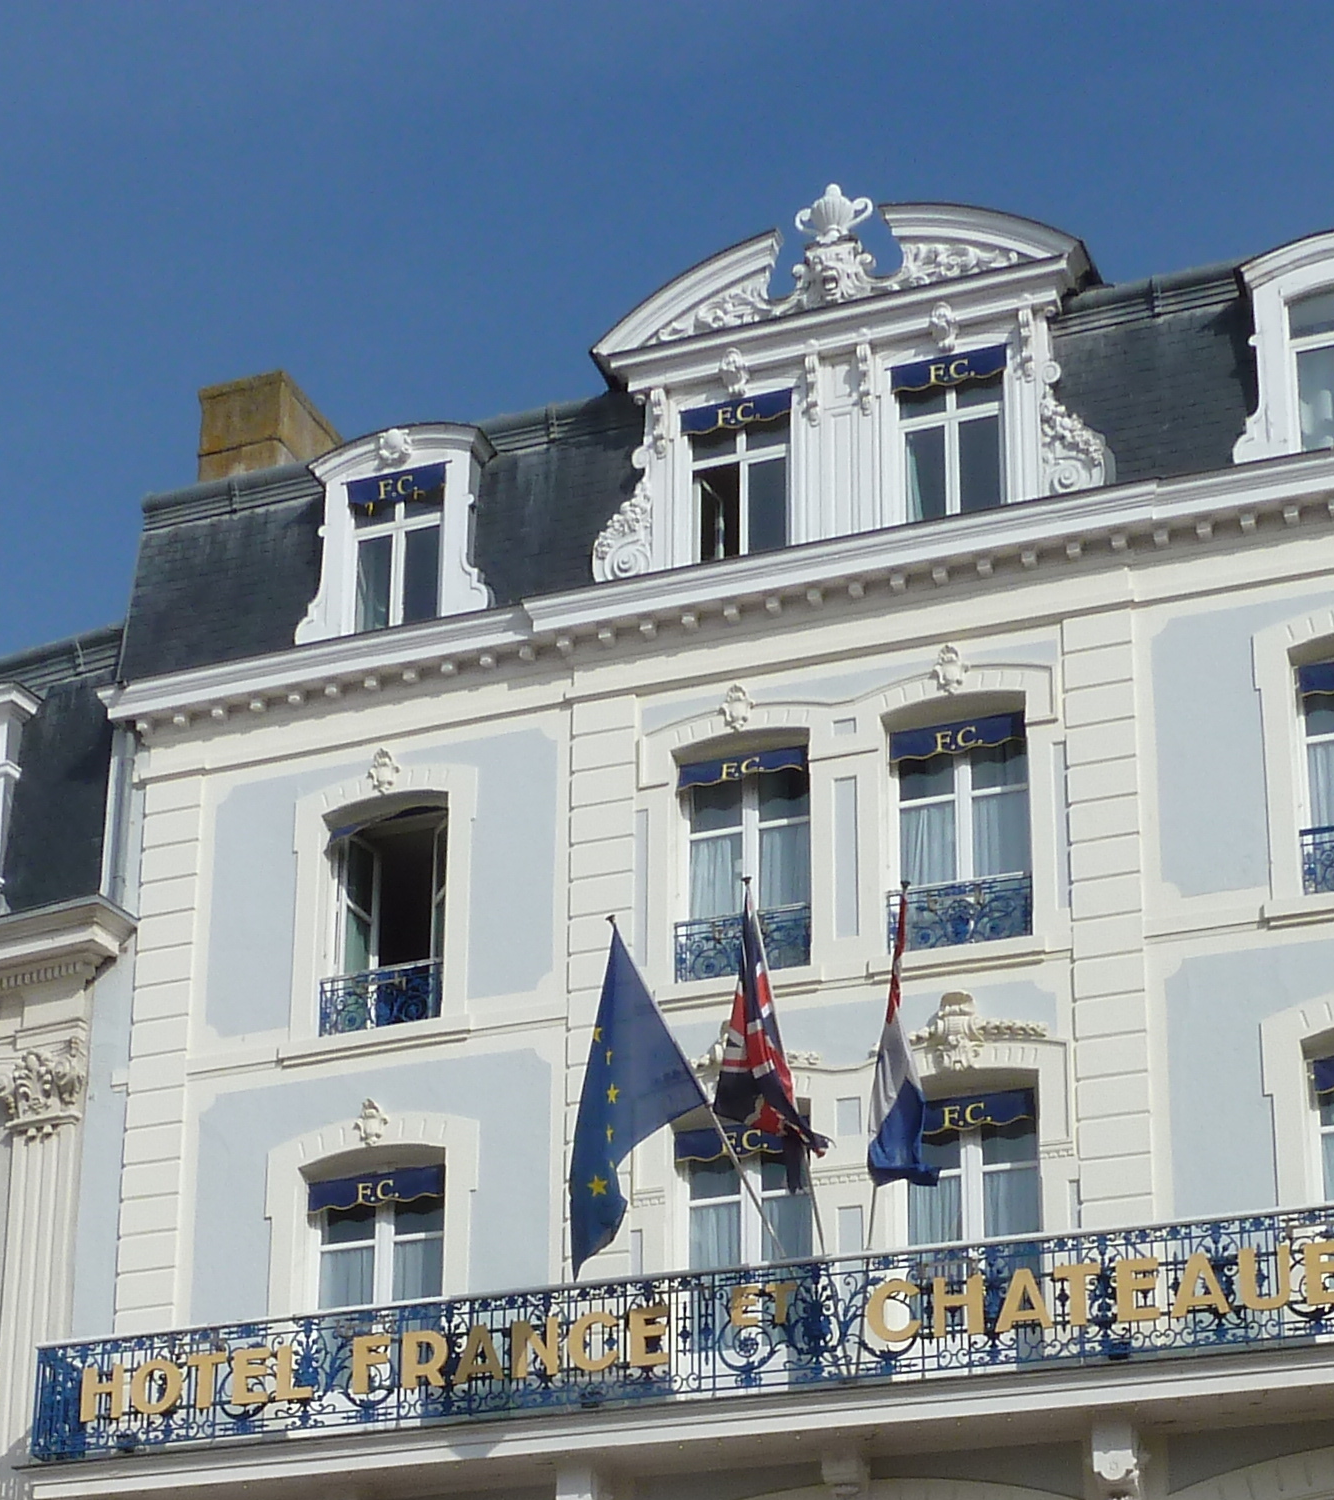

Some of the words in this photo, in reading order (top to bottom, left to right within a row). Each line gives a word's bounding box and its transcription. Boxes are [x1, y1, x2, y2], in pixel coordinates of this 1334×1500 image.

[929, 358, 975, 383] F.C.
[717, 402, 760, 427] F.C.
[379, 475, 418, 499] F.C.
[935, 726, 983, 751] F.C.
[721, 757, 764, 780] F.C.
[943, 1102, 992, 1128] F.C.
[357, 1179, 399, 1203] F.C.
[79, 1347, 312, 1422] HOTEL
[351, 1305, 669, 1395] FRANCE
[730, 1281, 798, 1327] ET
